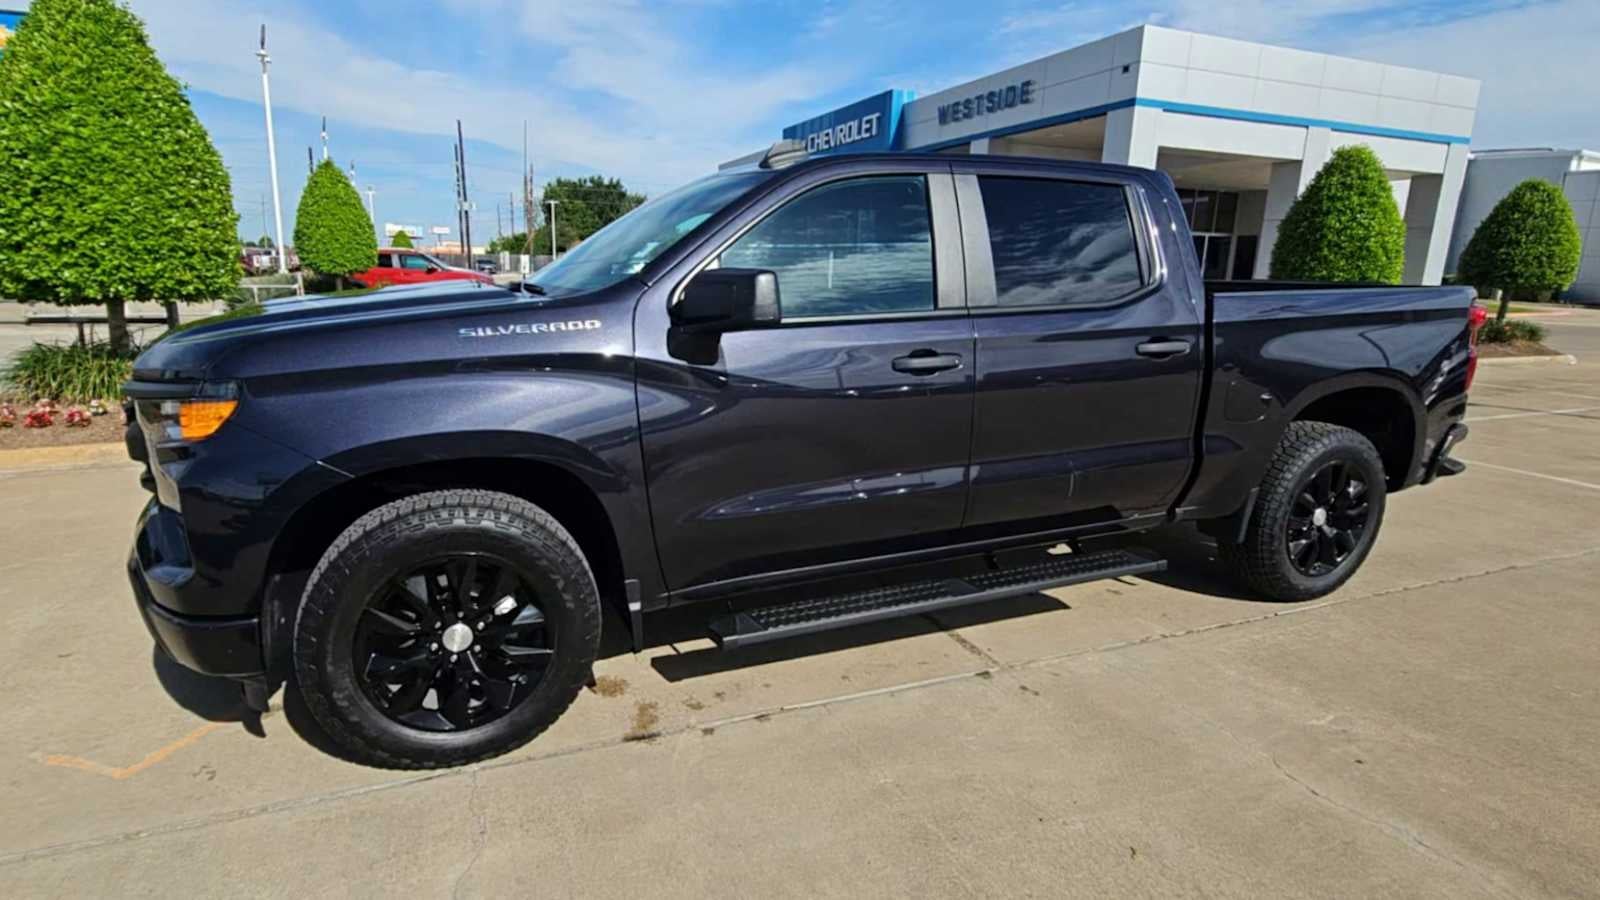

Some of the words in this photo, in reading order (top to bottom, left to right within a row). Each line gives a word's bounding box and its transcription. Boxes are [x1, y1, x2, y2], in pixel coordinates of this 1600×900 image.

[937, 80, 1034, 126] WESTSIDE
[807, 112, 881, 153] CHEVROLET
[458, 319, 602, 337] SILVERADO
